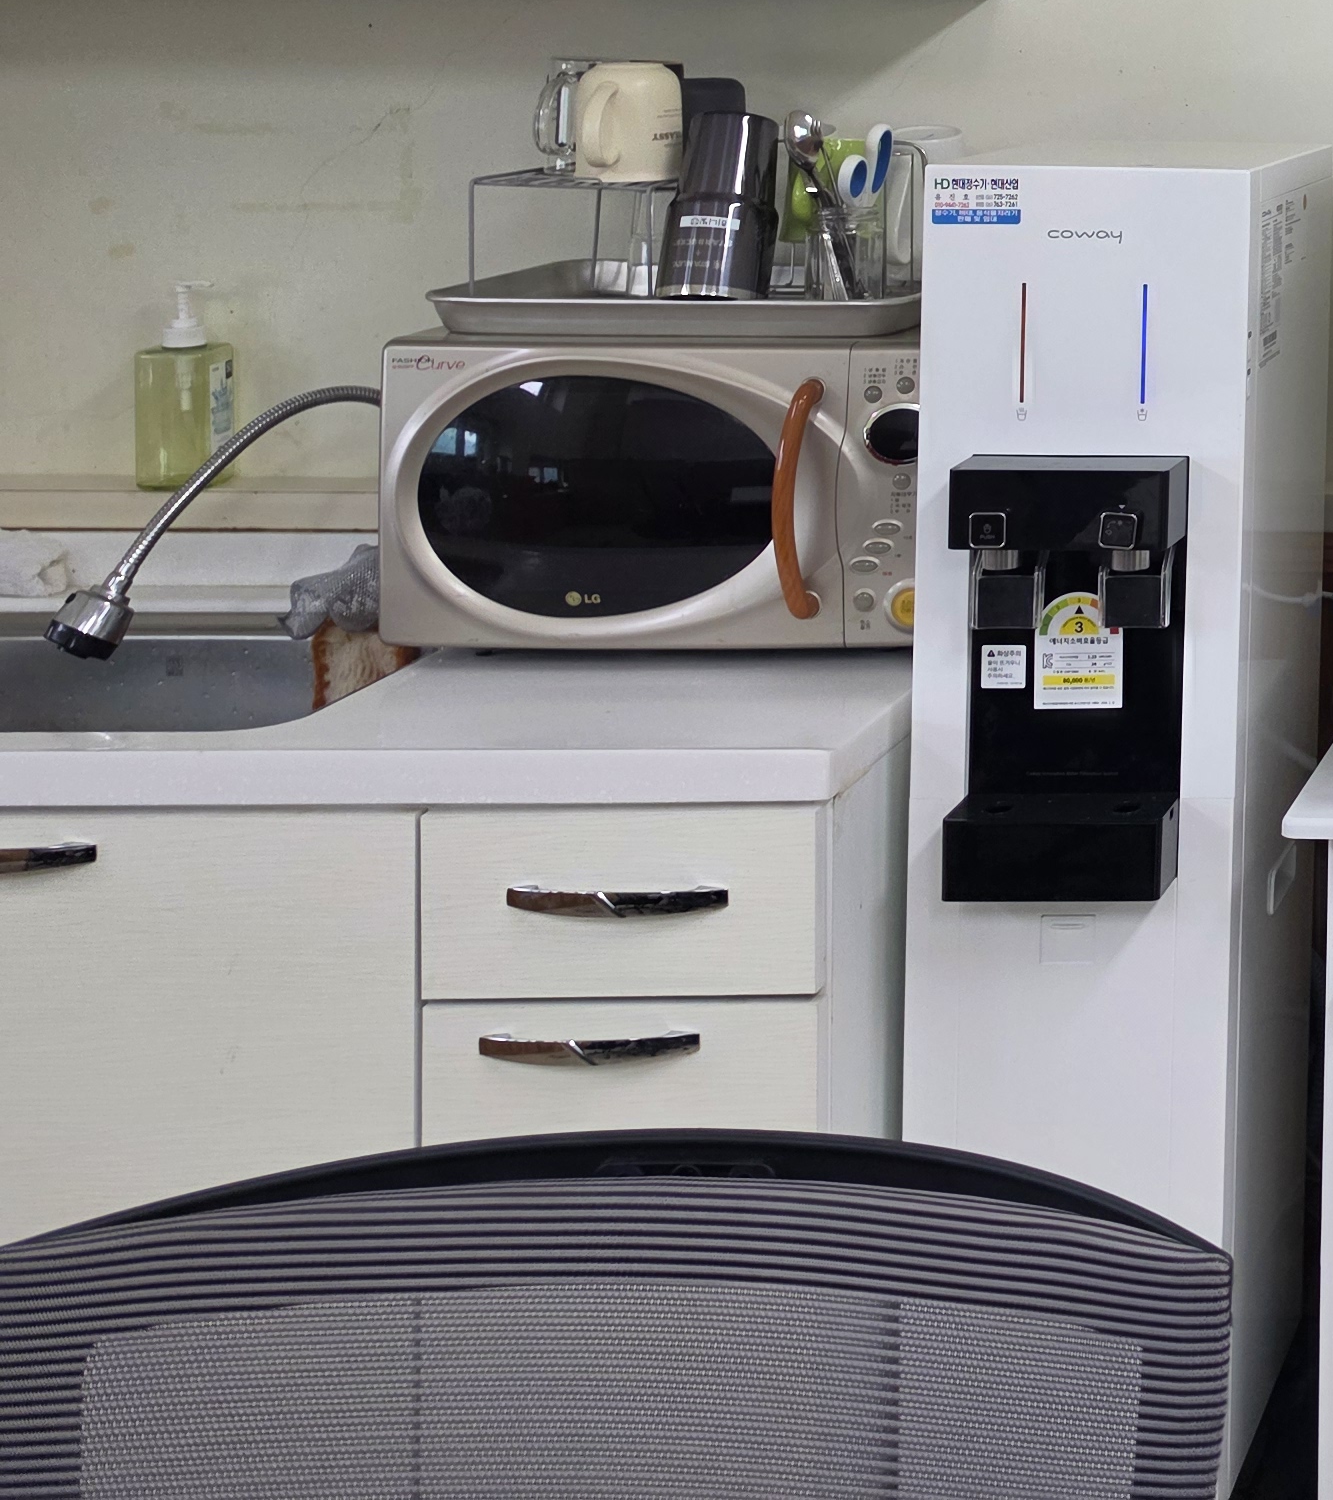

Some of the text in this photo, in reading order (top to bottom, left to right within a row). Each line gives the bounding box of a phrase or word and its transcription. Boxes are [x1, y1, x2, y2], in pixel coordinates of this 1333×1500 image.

[934, 177, 951, 190] HD
[1047, 229, 1123, 245] coway
[584, 593, 601, 604] LG
[1074, 620, 1084, 634] 3
